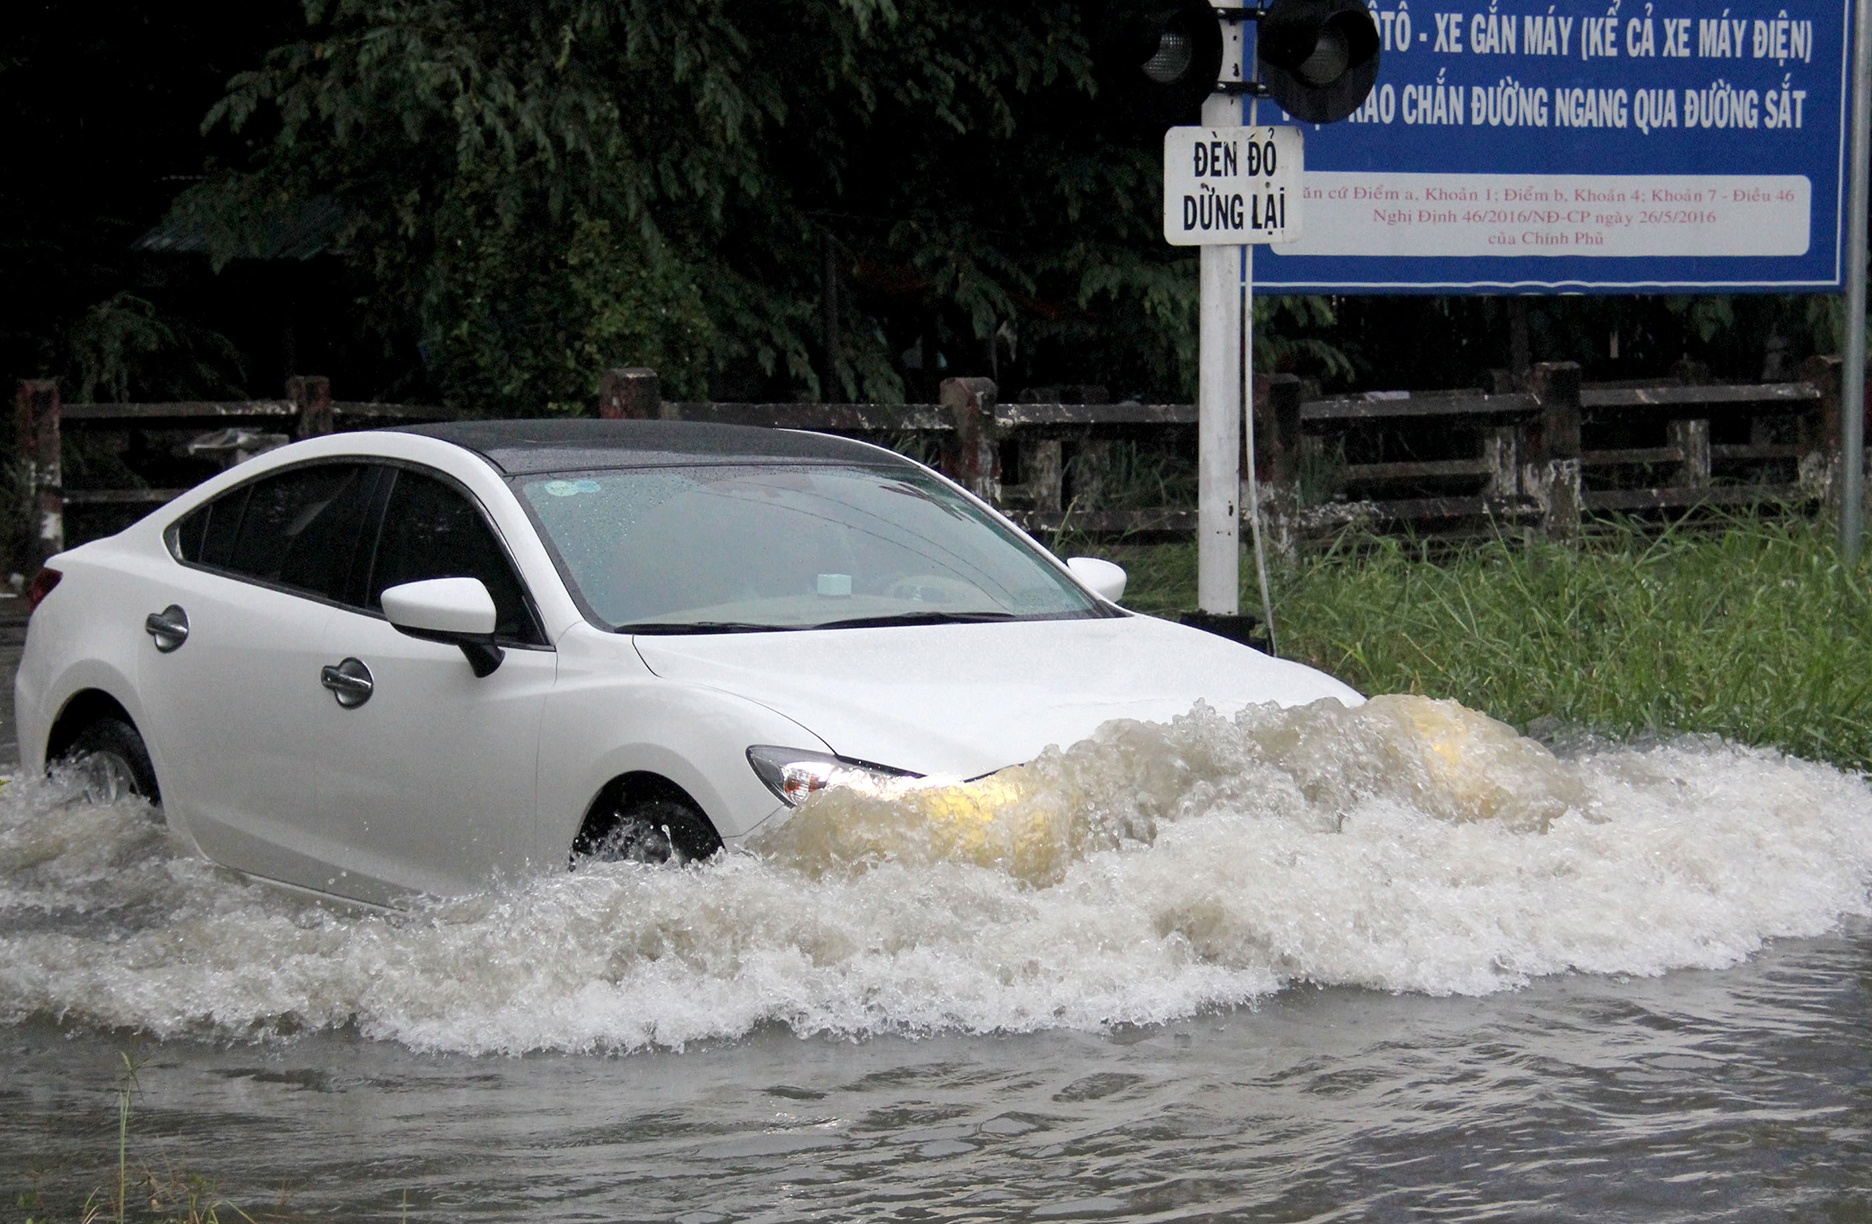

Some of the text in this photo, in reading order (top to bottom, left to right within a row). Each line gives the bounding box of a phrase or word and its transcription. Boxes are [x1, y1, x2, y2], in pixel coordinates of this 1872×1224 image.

[1434, 13, 1463, 53] XE
[1470, 0, 1516, 54] GẮN
[1524, 5, 1574, 56] MÁY
[1581, 0, 1621, 61] (KỂ
[1626, 2, 1655, 57] CẢ
[1662, 18, 1691, 57] XE
[1698, 8, 1747, 58] MÁY
[1753, 9, 1813, 67] ĐIỆN)
[1402, 67, 1464, 125] CHẮN
[1471, 76, 1548, 127] ĐƯỜNG
[1555, 88, 1628, 128] NGANG
[1634, 88, 1678, 135] QUA
[1684, 78, 1759, 129] ĐƯỜNG
[1764, 73, 1806, 129] SẮT
[1193, 127, 1277, 177] ĐÈN ĐỎ
[1183, 182, 1285, 235] DỪNG LẠI
[1303, 187, 1322, 199] ăn
[1328, 186, 1349, 199] cứ
[1354, 184, 1399, 200] Điểm
[1425, 187, 1478, 201] Khoản
[1504, 186, 1549, 202] Điểm
[1575, 188, 1626, 202] Khoản
[1708, 189, 1717, 202] 7
[1775, 189, 1795, 202] 46
[1374, 208, 1412, 225] Nghị
[1418, 209, 1457, 226] Định
[1595, 212, 1633, 227] ngày
[1639, 210, 1717, 224] 26/5/2016
